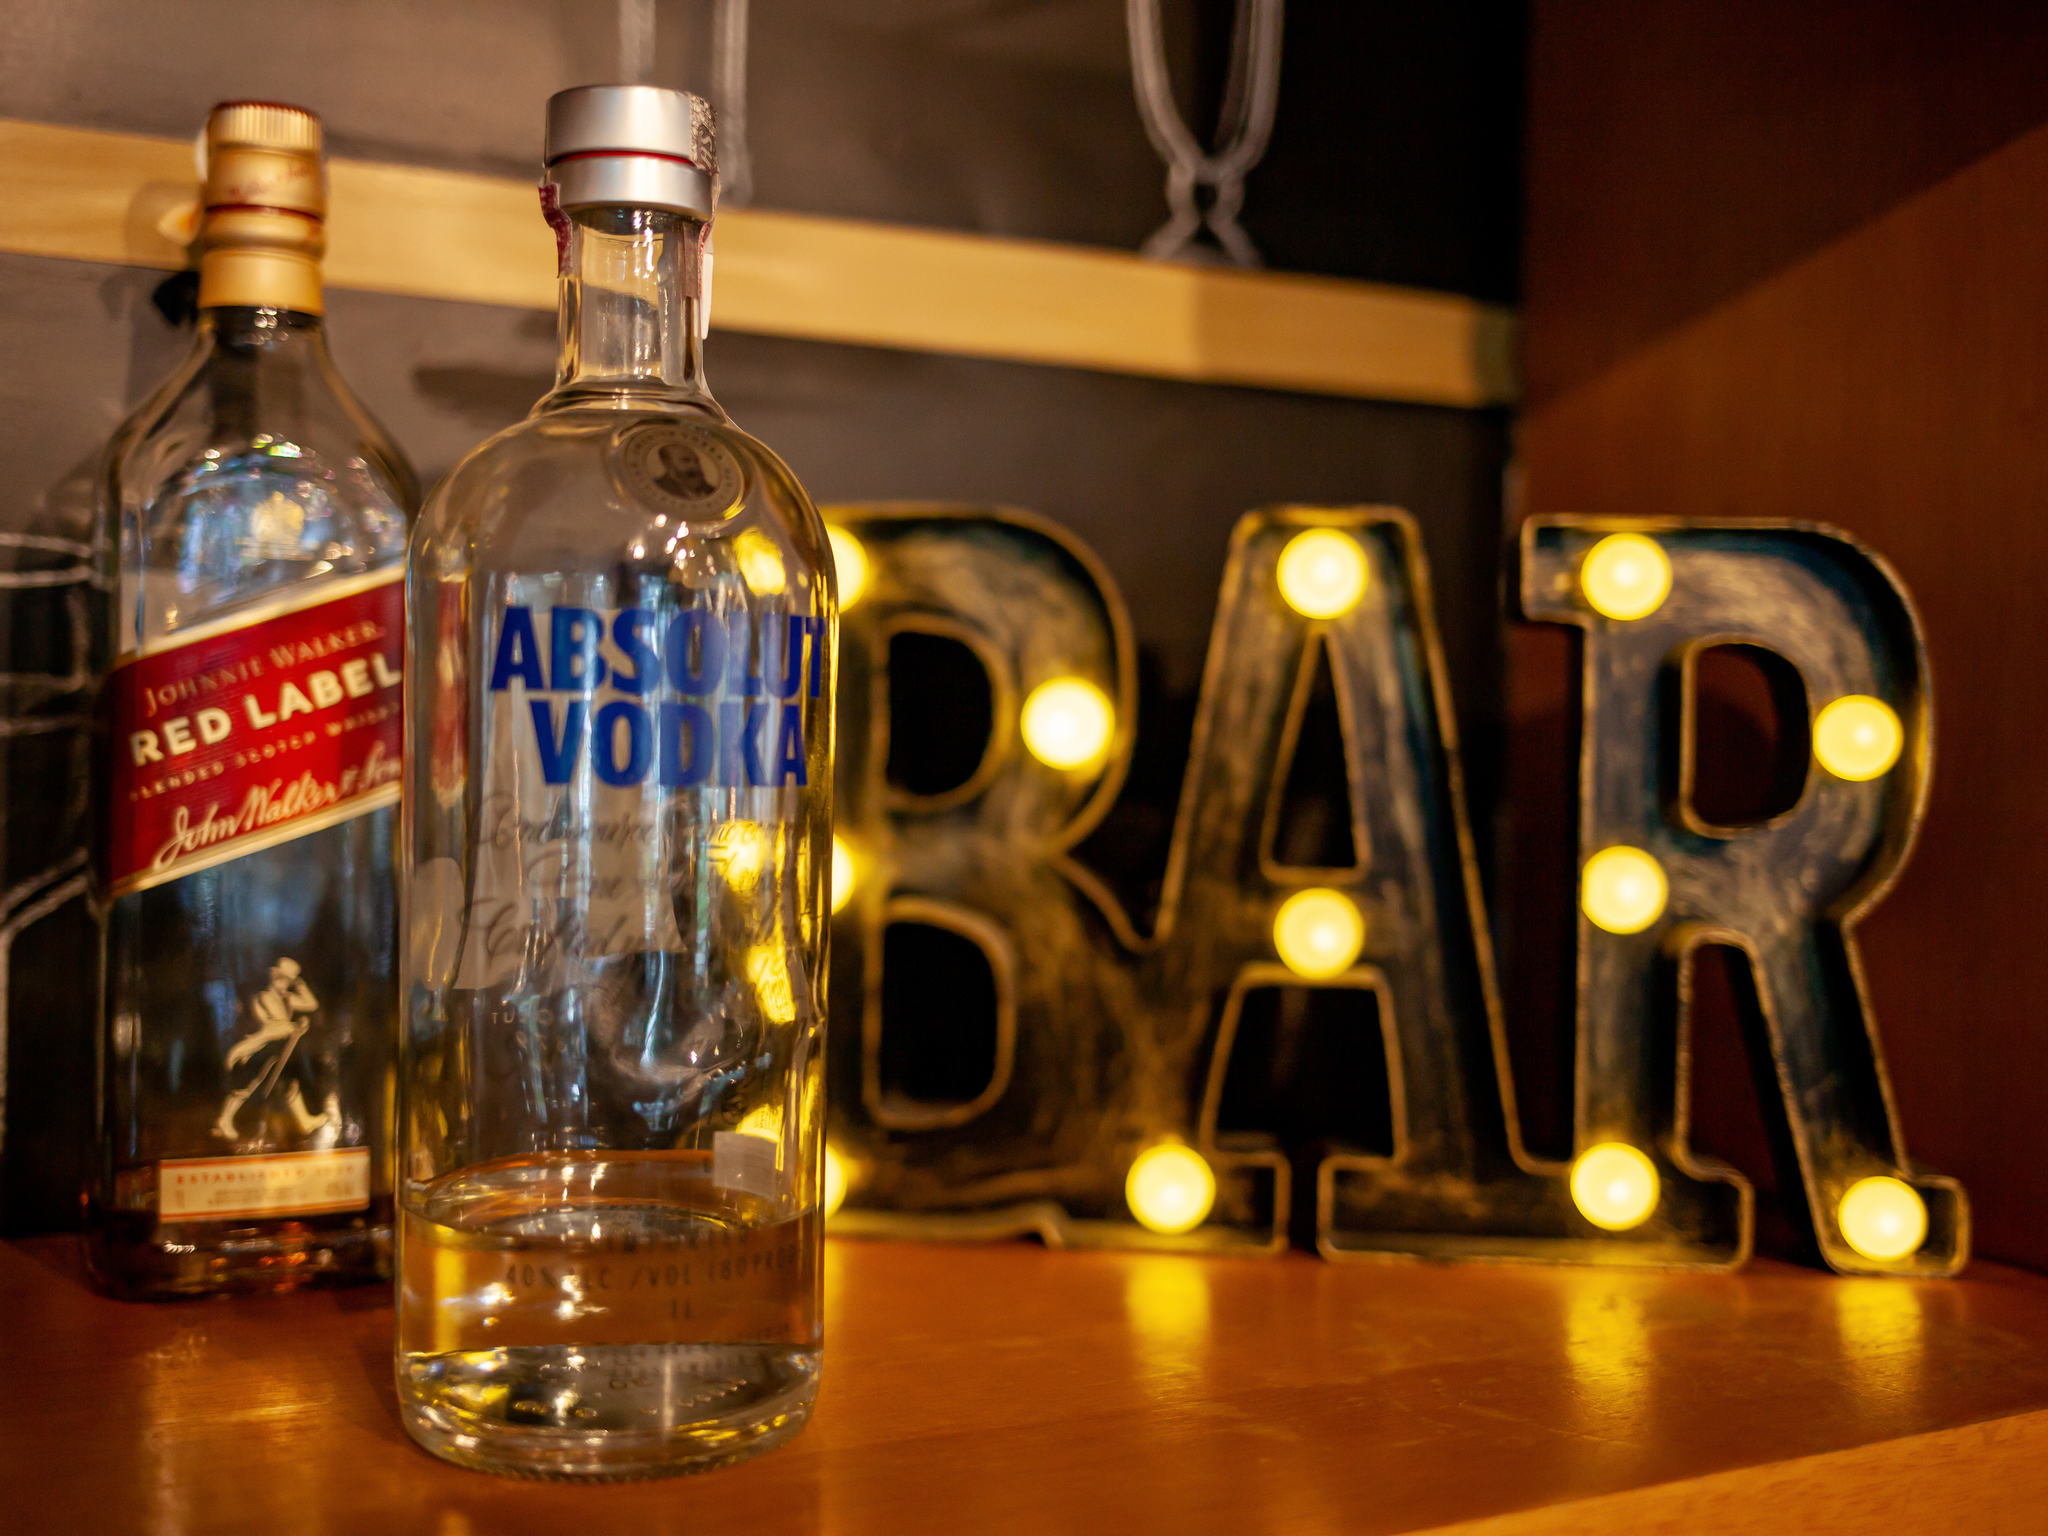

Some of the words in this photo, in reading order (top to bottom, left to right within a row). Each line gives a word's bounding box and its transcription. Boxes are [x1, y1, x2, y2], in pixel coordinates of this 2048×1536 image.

[144, 655, 263, 718] JOHNNIE
[269, 619, 385, 669] WALKER
[490, 605, 826, 699] ABSOLUT
[129, 706, 232, 767] RED
[243, 652, 403, 730] LABEL
[530, 699, 808, 787] VODKA
[153, 804, 240, 871] John
[828, 503, 1969, 1278] BAR
